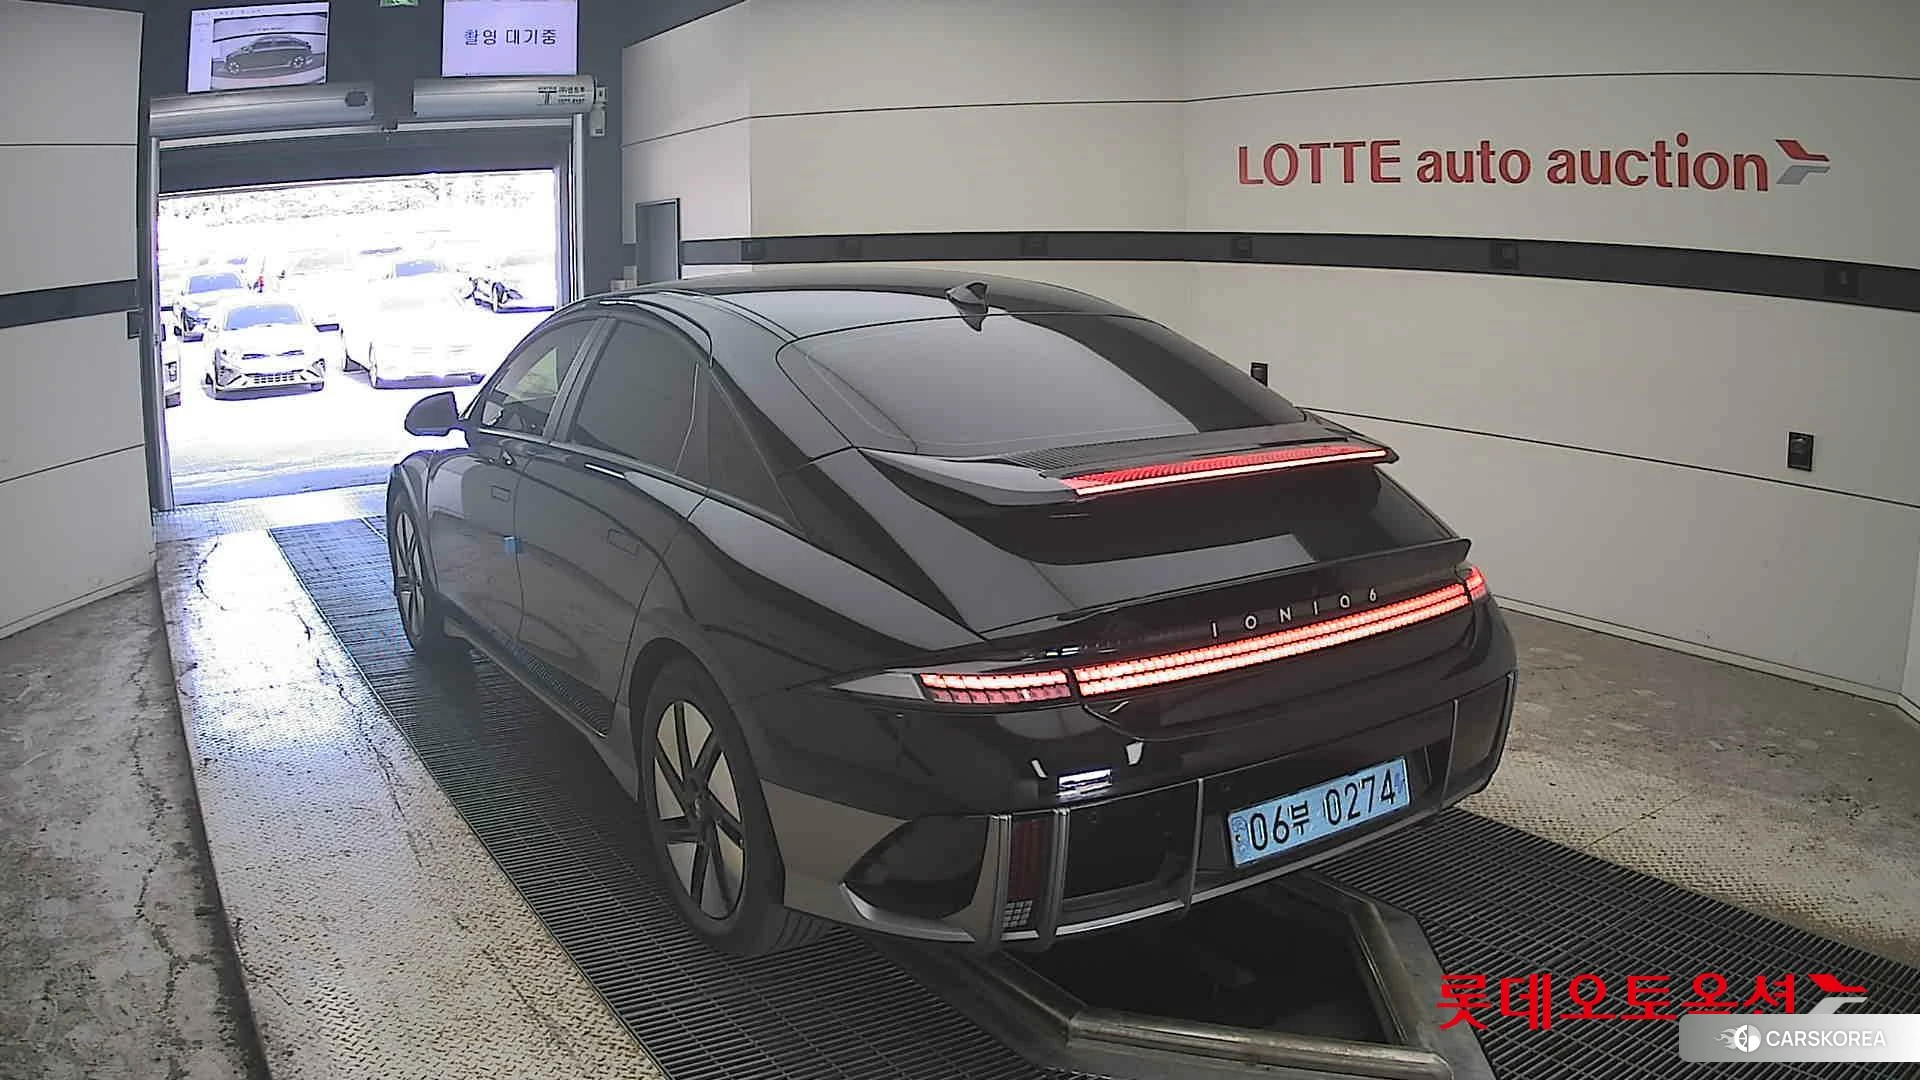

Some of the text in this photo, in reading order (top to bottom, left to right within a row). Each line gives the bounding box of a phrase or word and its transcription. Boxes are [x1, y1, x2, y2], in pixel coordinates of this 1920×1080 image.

[505, 28, 557, 46] 대기중
[1239, 132, 1769, 192] LOTTE auto auction
[1324, 768, 1396, 826] 0274
